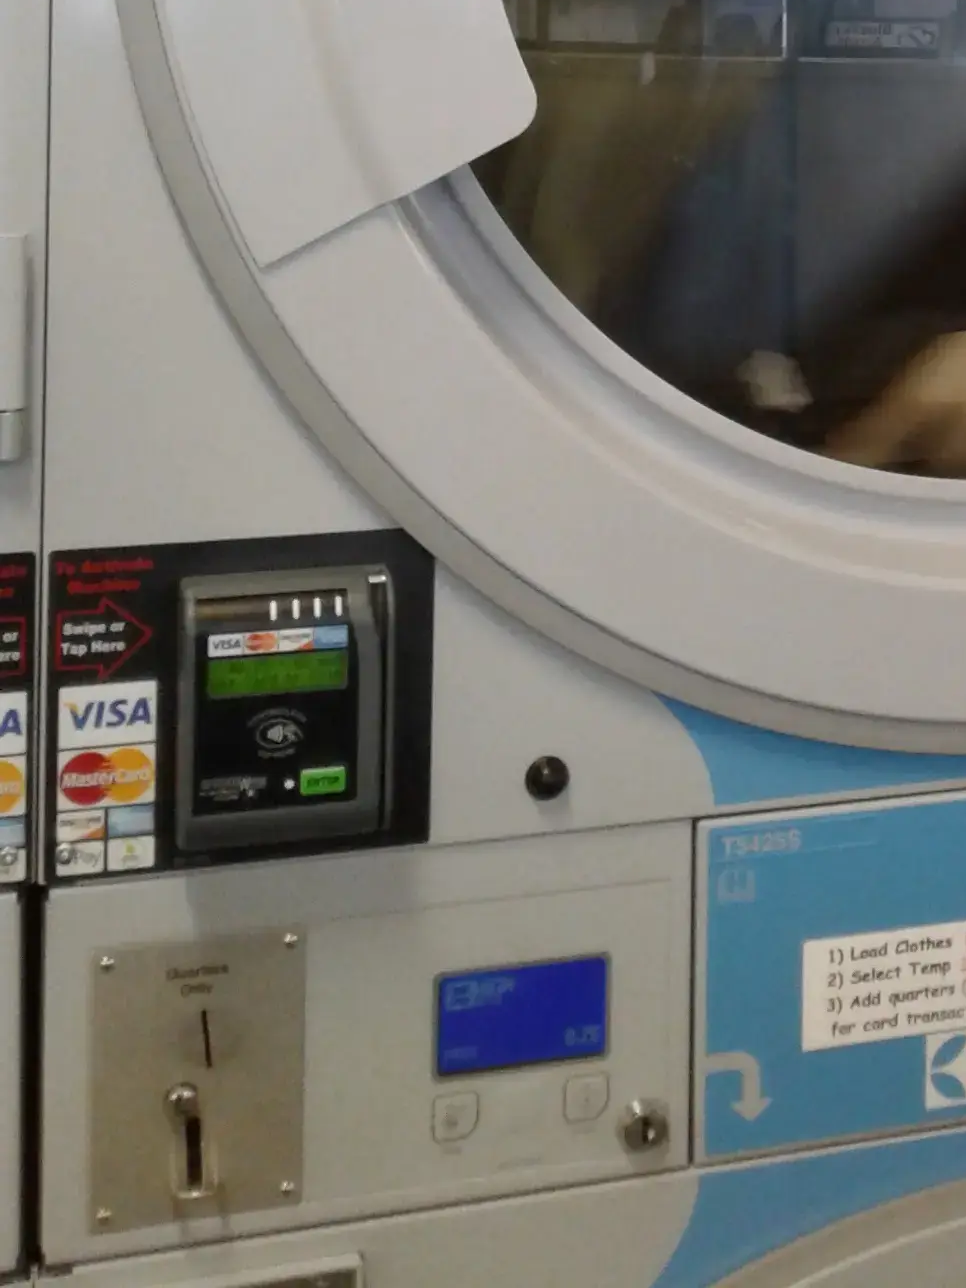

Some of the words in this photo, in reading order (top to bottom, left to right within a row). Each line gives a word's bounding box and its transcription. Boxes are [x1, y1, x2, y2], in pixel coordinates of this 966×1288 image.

[2, 631, 19, 643] or
[63, 621, 106, 637] Swipe
[110, 622, 125, 633] or
[61, 642, 87, 657] Tap
[91, 640, 126, 653] Here
[212, 638, 241, 651] VISA
[65, 697, 152, 731] VISA
[61, 768, 150, 789] MasterCard
[828, 948, 844, 965] 1)
[850, 943, 888, 962] Load
[895, 937, 953, 955] Clothes
[826, 972, 844, 990] 2)
[850, 966, 901, 986] Select
[908, 960, 952, 978] Temp
[825, 996, 843, 1015] 3)
[849, 991, 881, 1010] Add
[887, 983, 956, 1008] quarters
[830, 1021, 856, 1037] for
[862, 1014, 899, 1032] card
